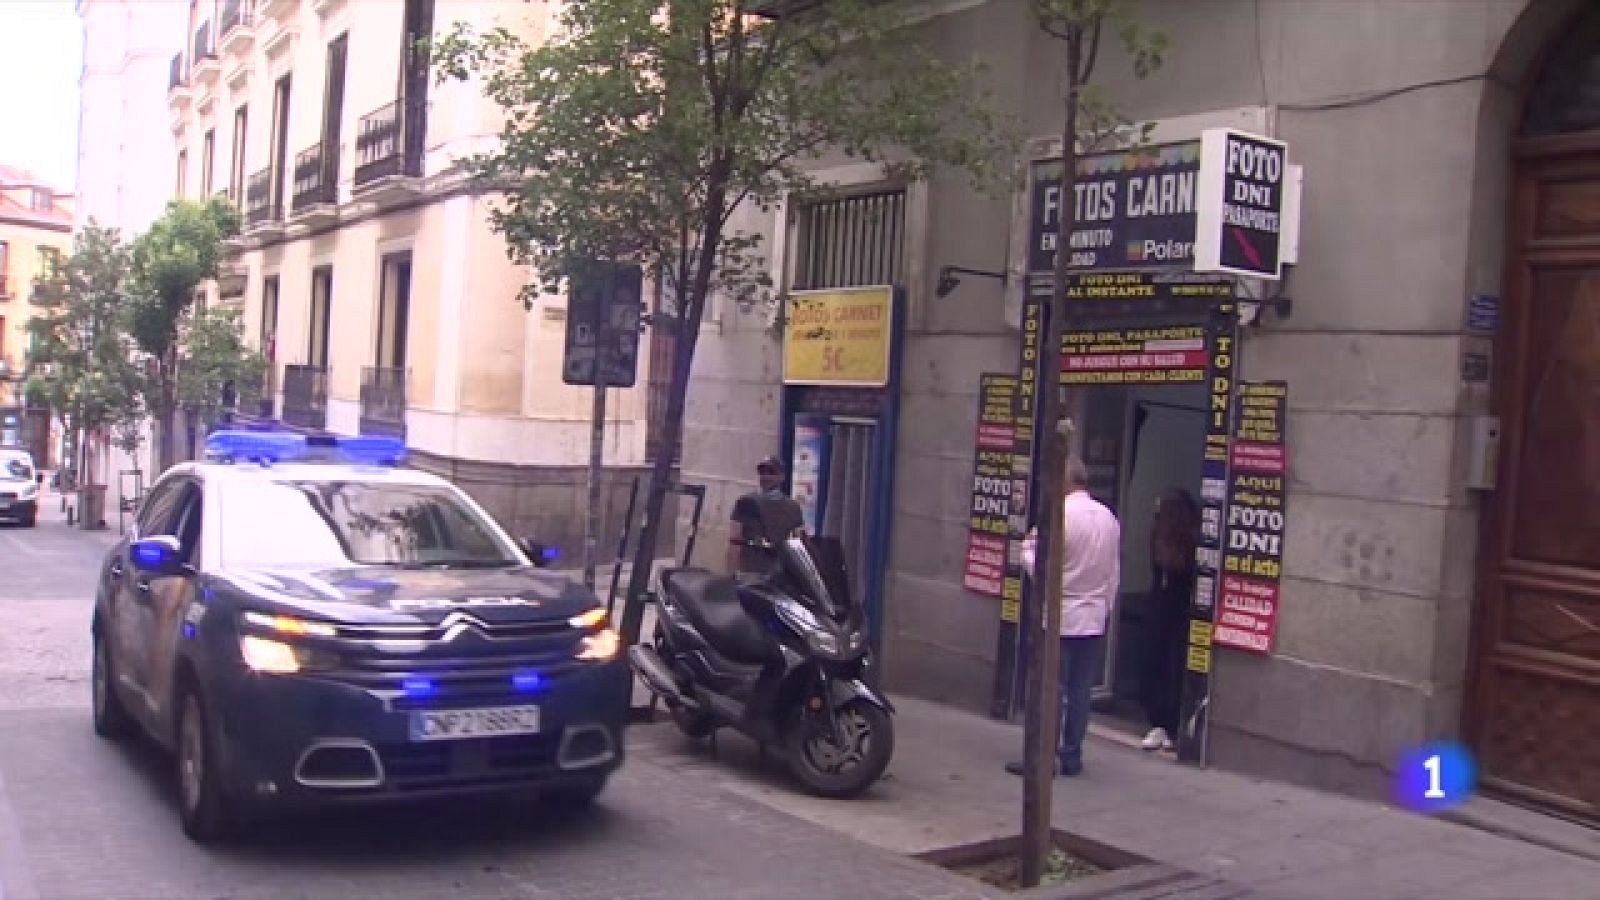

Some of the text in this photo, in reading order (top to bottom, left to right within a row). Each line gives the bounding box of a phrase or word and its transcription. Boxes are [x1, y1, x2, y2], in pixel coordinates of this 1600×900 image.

[1227, 139, 1281, 183] FOTO
[1043, 169, 1200, 226] FTOS CARN
[1233, 179, 1271, 206] DNI
[1223, 203, 1281, 233] PASAPORTE
[1086, 285, 1156, 297] INSTANTE
[834, 304, 882, 322] CARNET
[1024, 304, 1039, 361] FOTO
[1020, 367, 1034, 411] DNI
[1211, 377, 1229, 426] DNI
[974, 476, 1011, 495] FOTO
[974, 495, 1009, 515] DNI
[1227, 504, 1284, 531] FOTO
[1228, 529, 1281, 556] DNI
